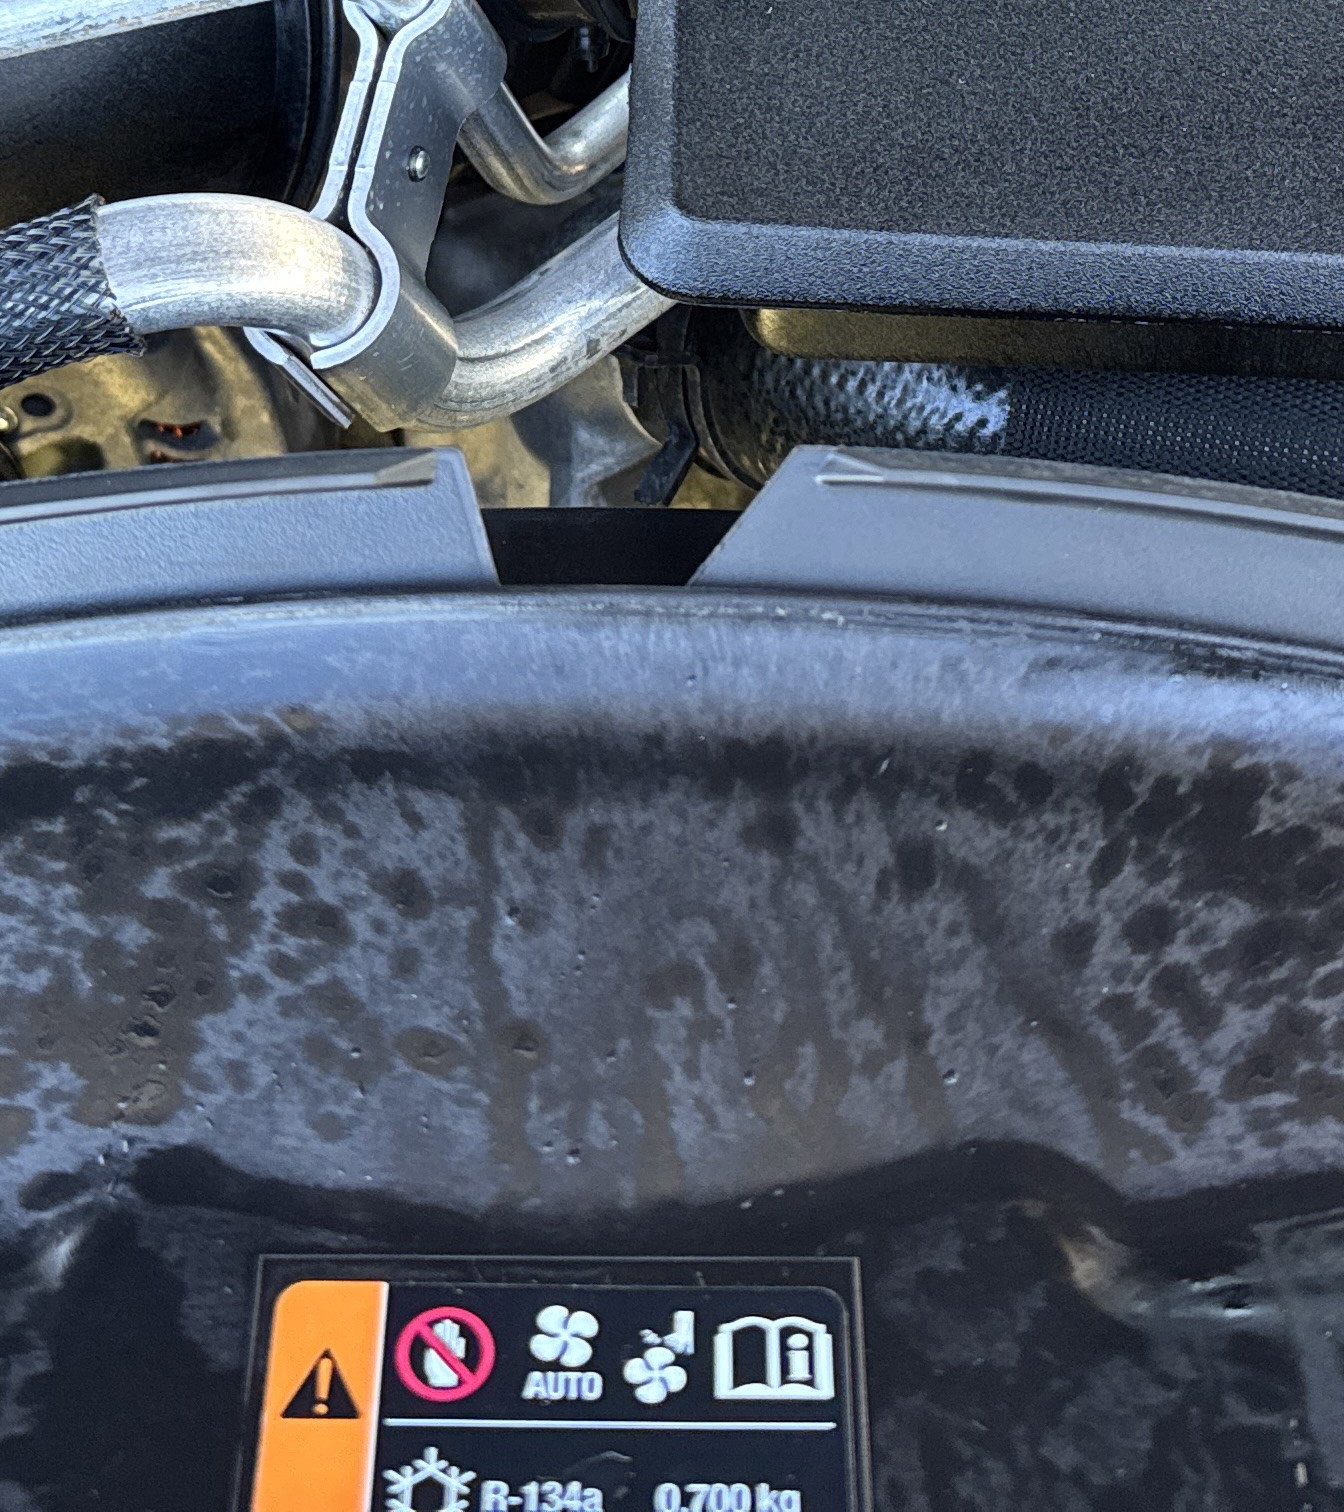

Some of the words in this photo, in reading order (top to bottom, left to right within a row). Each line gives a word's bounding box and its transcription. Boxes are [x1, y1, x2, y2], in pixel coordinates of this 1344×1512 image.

[521, 1370, 604, 1401] AUTO
[480, 1480, 604, 1512] R-134a
[653, 1482, 752, 1512] 0.700
[755, 1482, 801, 1512] kg
